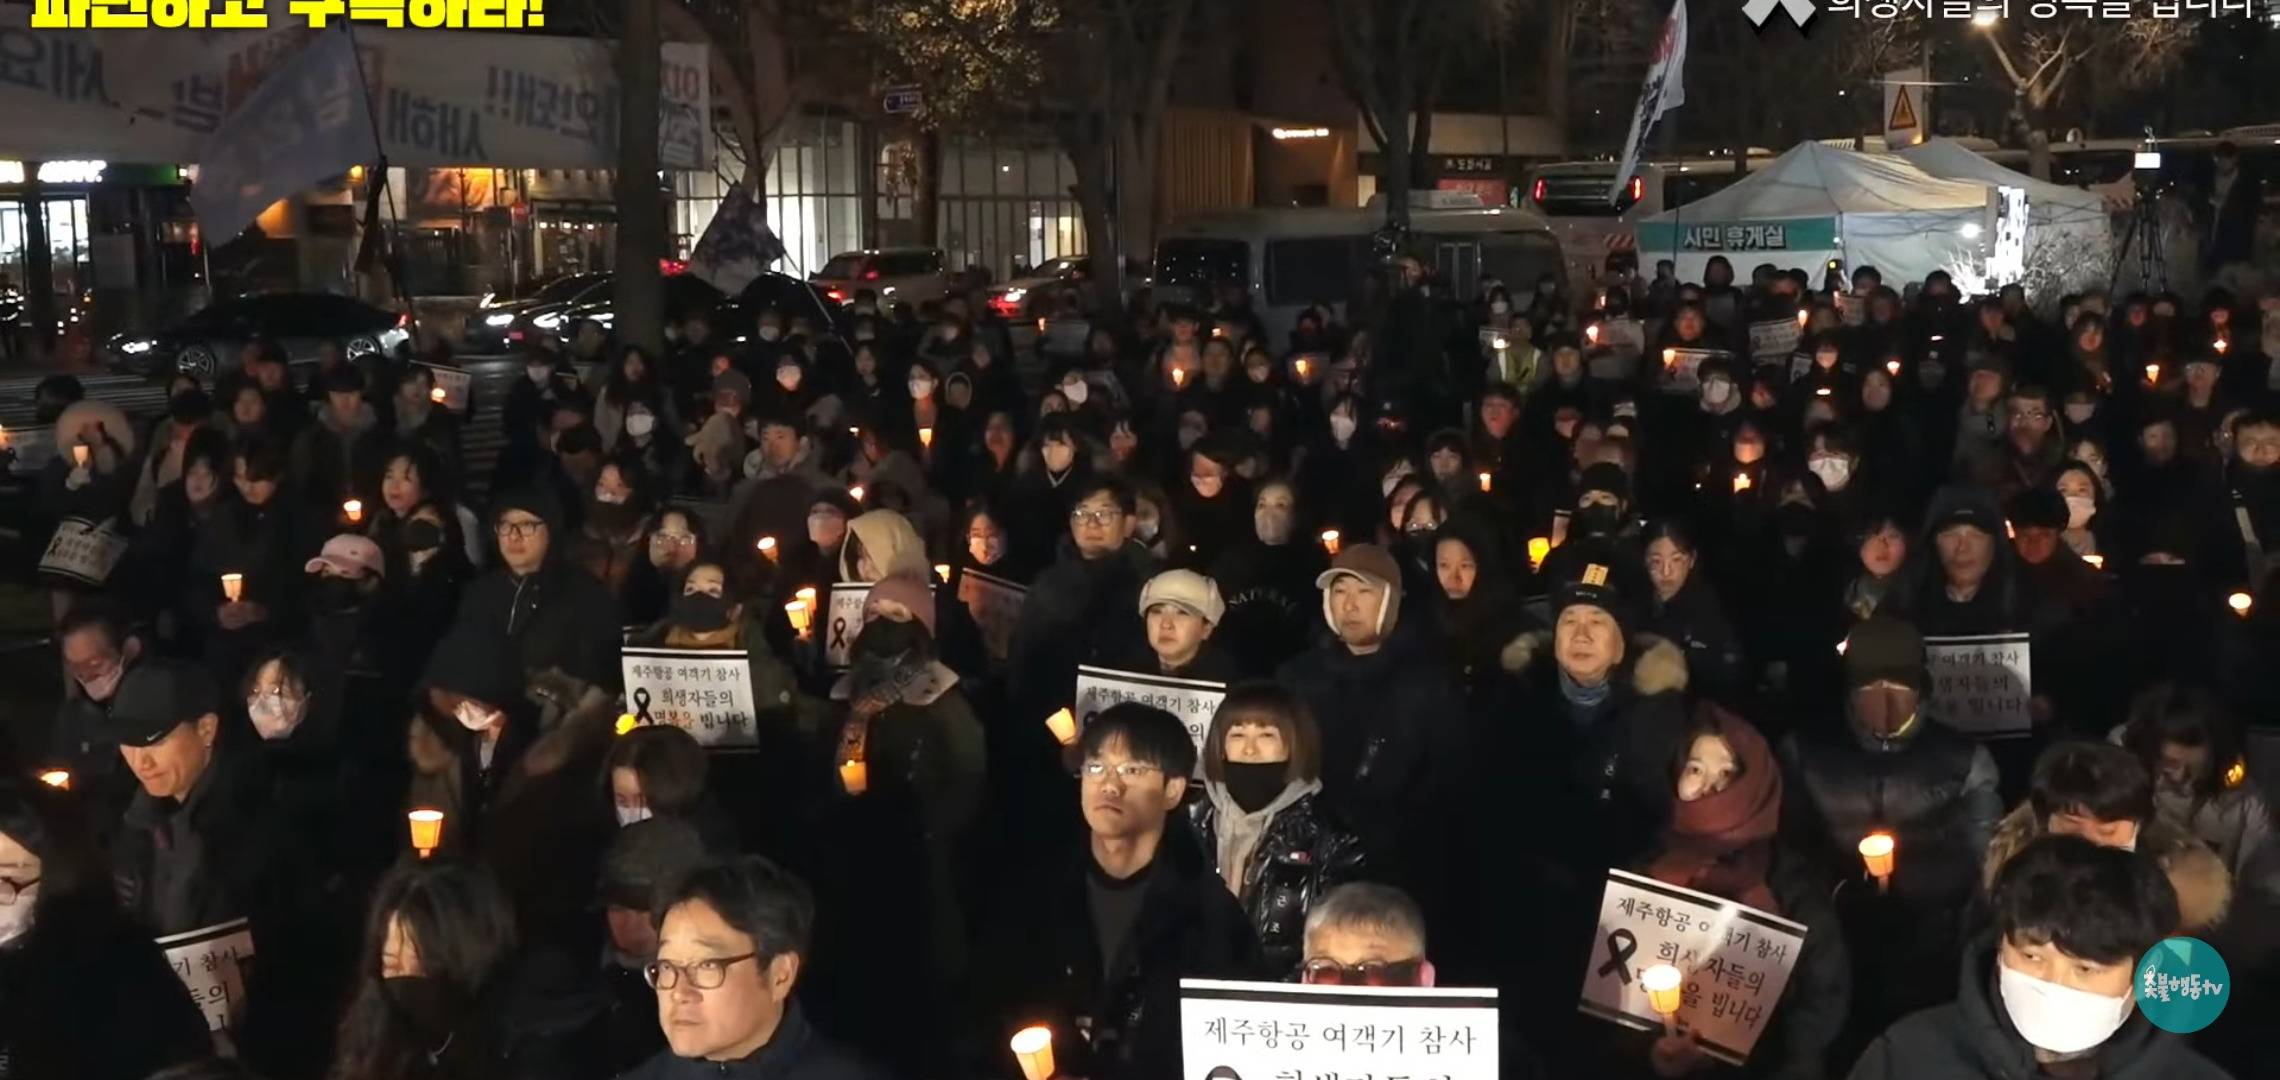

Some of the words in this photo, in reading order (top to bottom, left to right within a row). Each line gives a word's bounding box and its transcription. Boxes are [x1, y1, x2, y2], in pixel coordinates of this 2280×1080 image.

[1683, 227, 1721, 248] 시민
[1727, 225, 1784, 248] 휴게실
[677, 665, 711, 681] 여객기
[717, 667, 740, 681] 참사
[662, 687, 734, 708] 희생자들의
[1187, 699, 1216, 715] 참사
[700, 711, 749, 731] 빕니다
[1617, 896, 1690, 933] 제주항공
[1756, 936, 1788, 965] 참사
[1711, 991, 1763, 1030] 빕니다
[1204, 1016, 1311, 1051] 제주항공
[1322, 1023, 1404, 1055] 여객기
[1420, 1025, 1478, 1055] 참사
